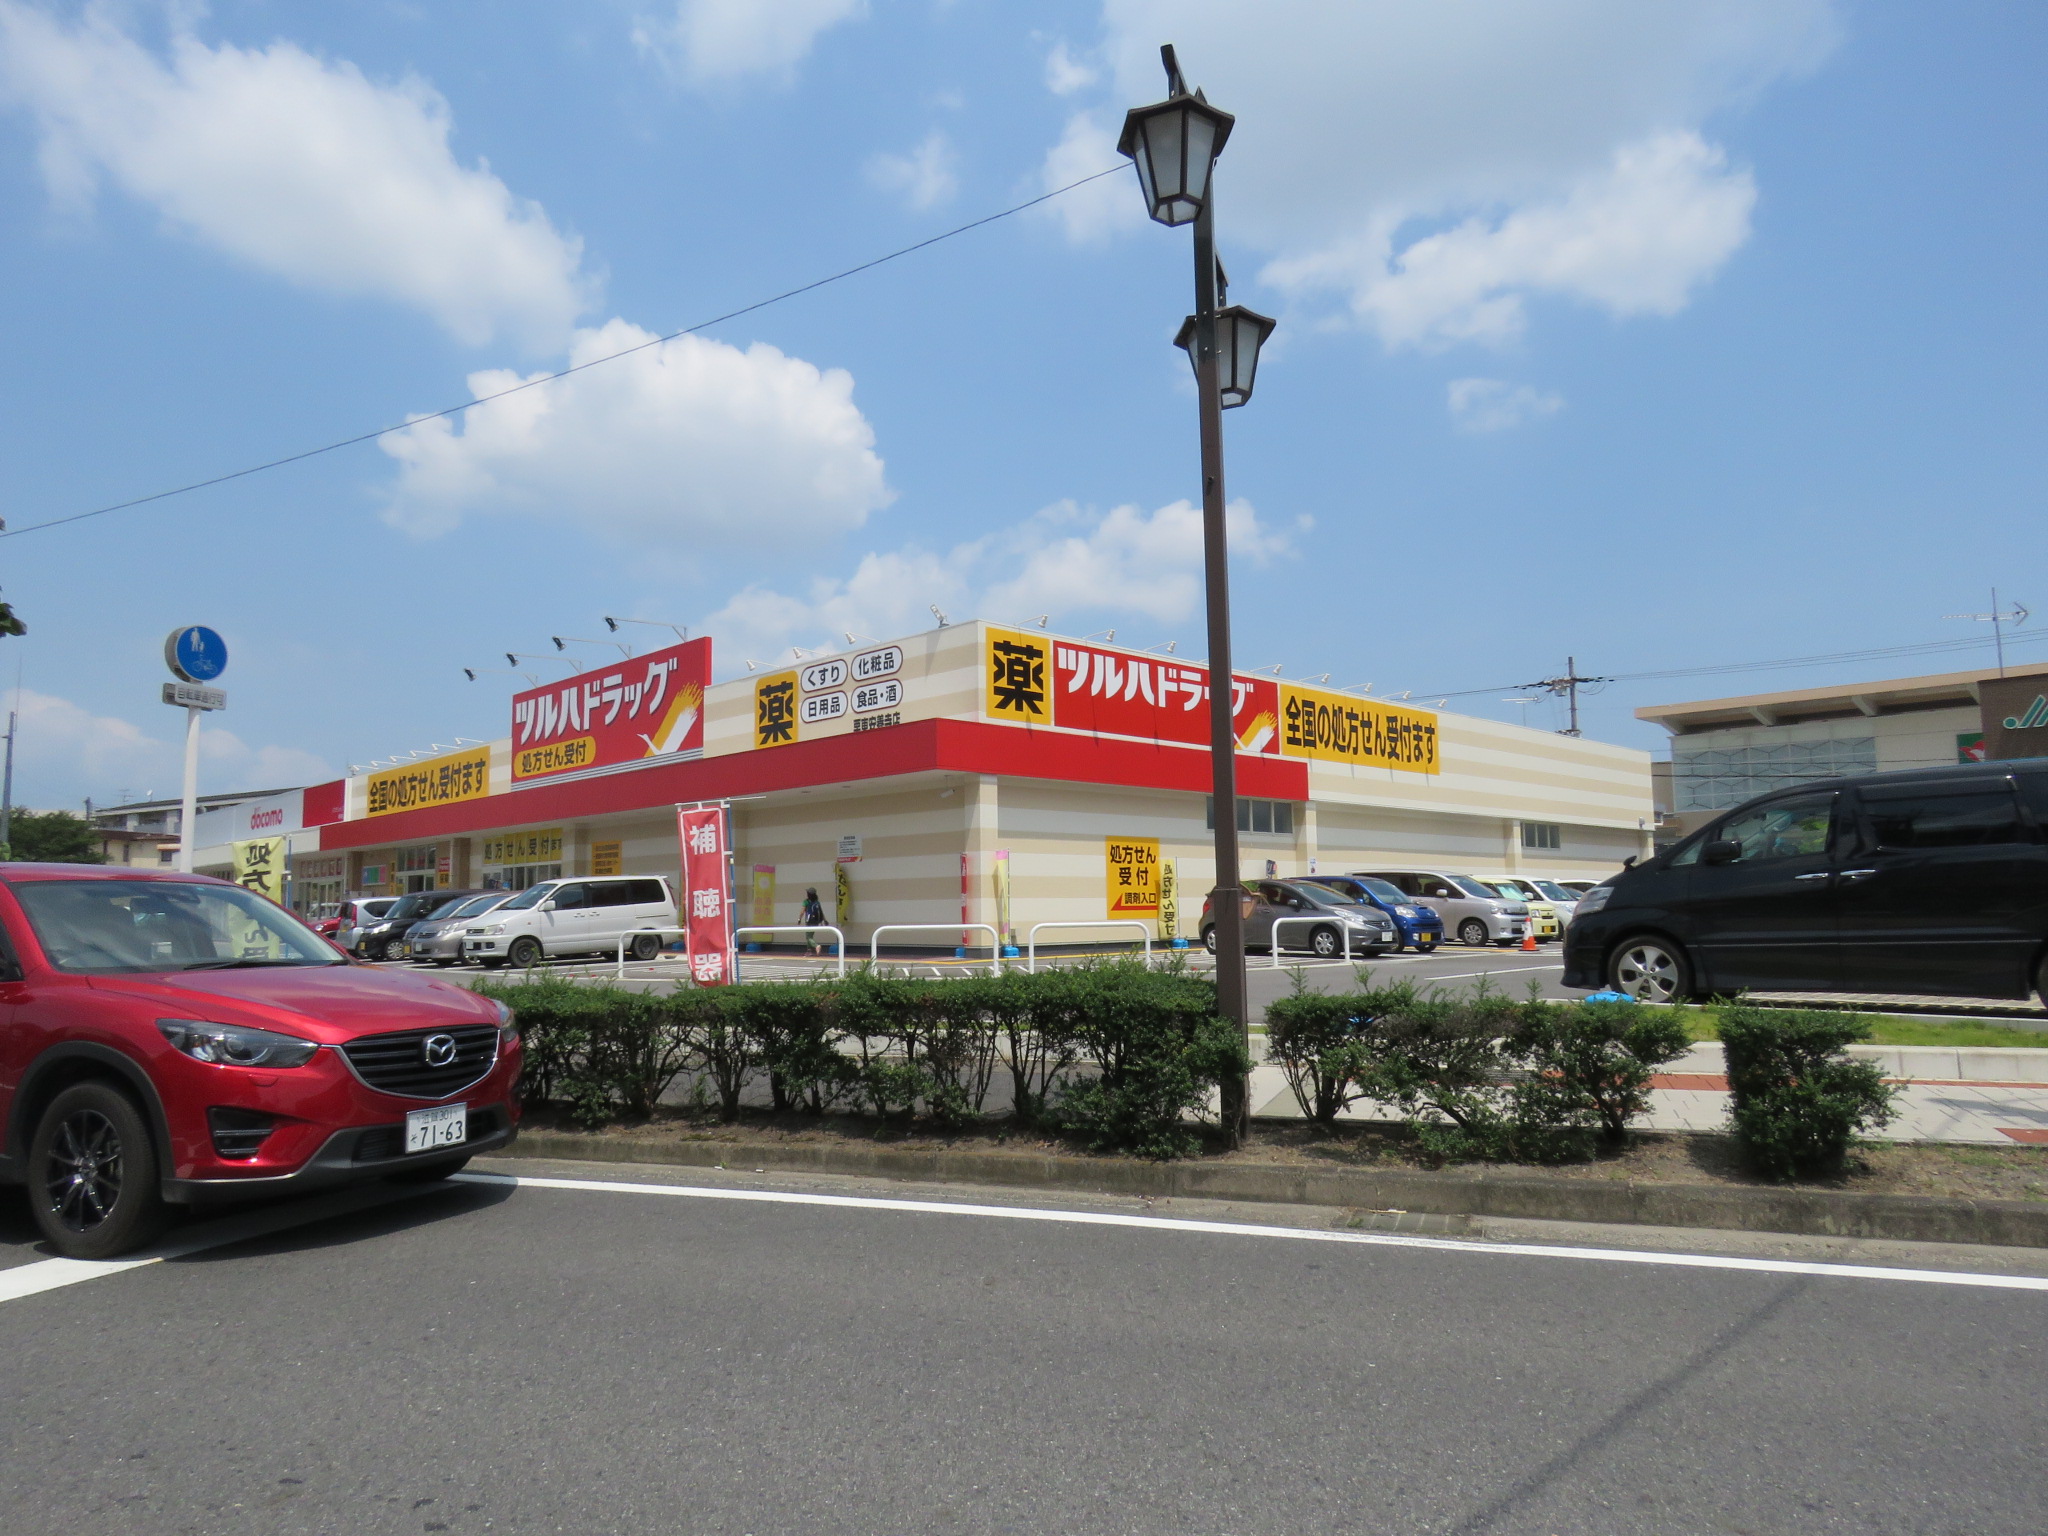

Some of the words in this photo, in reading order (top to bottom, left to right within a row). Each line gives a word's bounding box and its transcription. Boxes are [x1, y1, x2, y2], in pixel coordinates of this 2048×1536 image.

[807, 665, 840, 687] くすり
[858, 651, 895, 676] 化粧品
[993, 640, 1044, 715] 薬
[1057, 647, 1254, 717] ツルハドラグ
[515, 656, 678, 746] ツルハドラッグ
[808, 696, 841, 718] 日用品
[856, 684, 897, 709] 食品・酒
[759, 680, 794, 745] 薬
[1285, 695, 1436, 764] 全国の処方せん受付ます
[522, 740, 587, 774] 処方せん受付
[369, 758, 487, 813] 全国の処方せん受付ます
[250, 807, 283, 830] docomo
[1110, 844, 1156, 864] 処方せん
[1119, 866, 1149, 886] 受付
[689, 823, 723, 982] 補聴器
[1124, 892, 1157, 905] 調剤入口
[420, 1119, 463, 1147] 71-63
